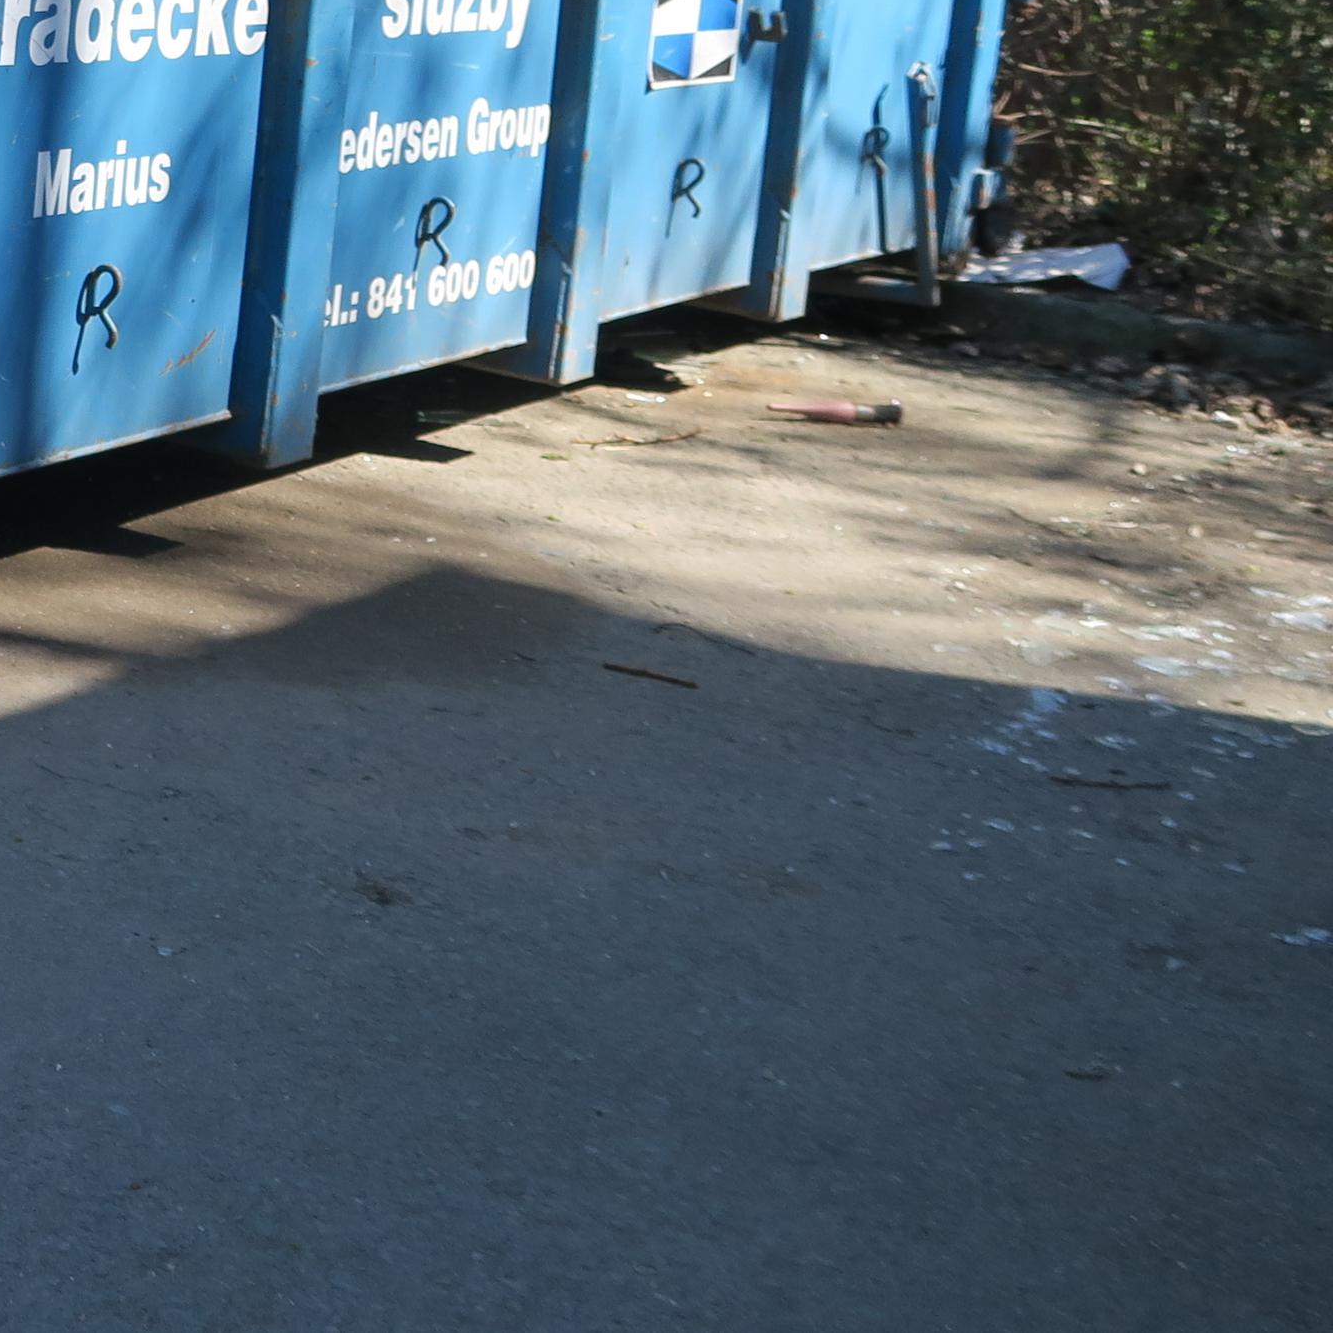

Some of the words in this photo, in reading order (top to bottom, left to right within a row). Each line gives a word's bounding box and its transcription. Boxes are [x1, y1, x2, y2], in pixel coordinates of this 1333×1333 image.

[33, 139, 172, 218] Marius
[338, 110, 459, 174] edersen
[465, 97, 551, 158] Group
[367, 272, 418, 319] 841
[427, 260, 480, 307] 600
[485, 250, 537, 297] 600
